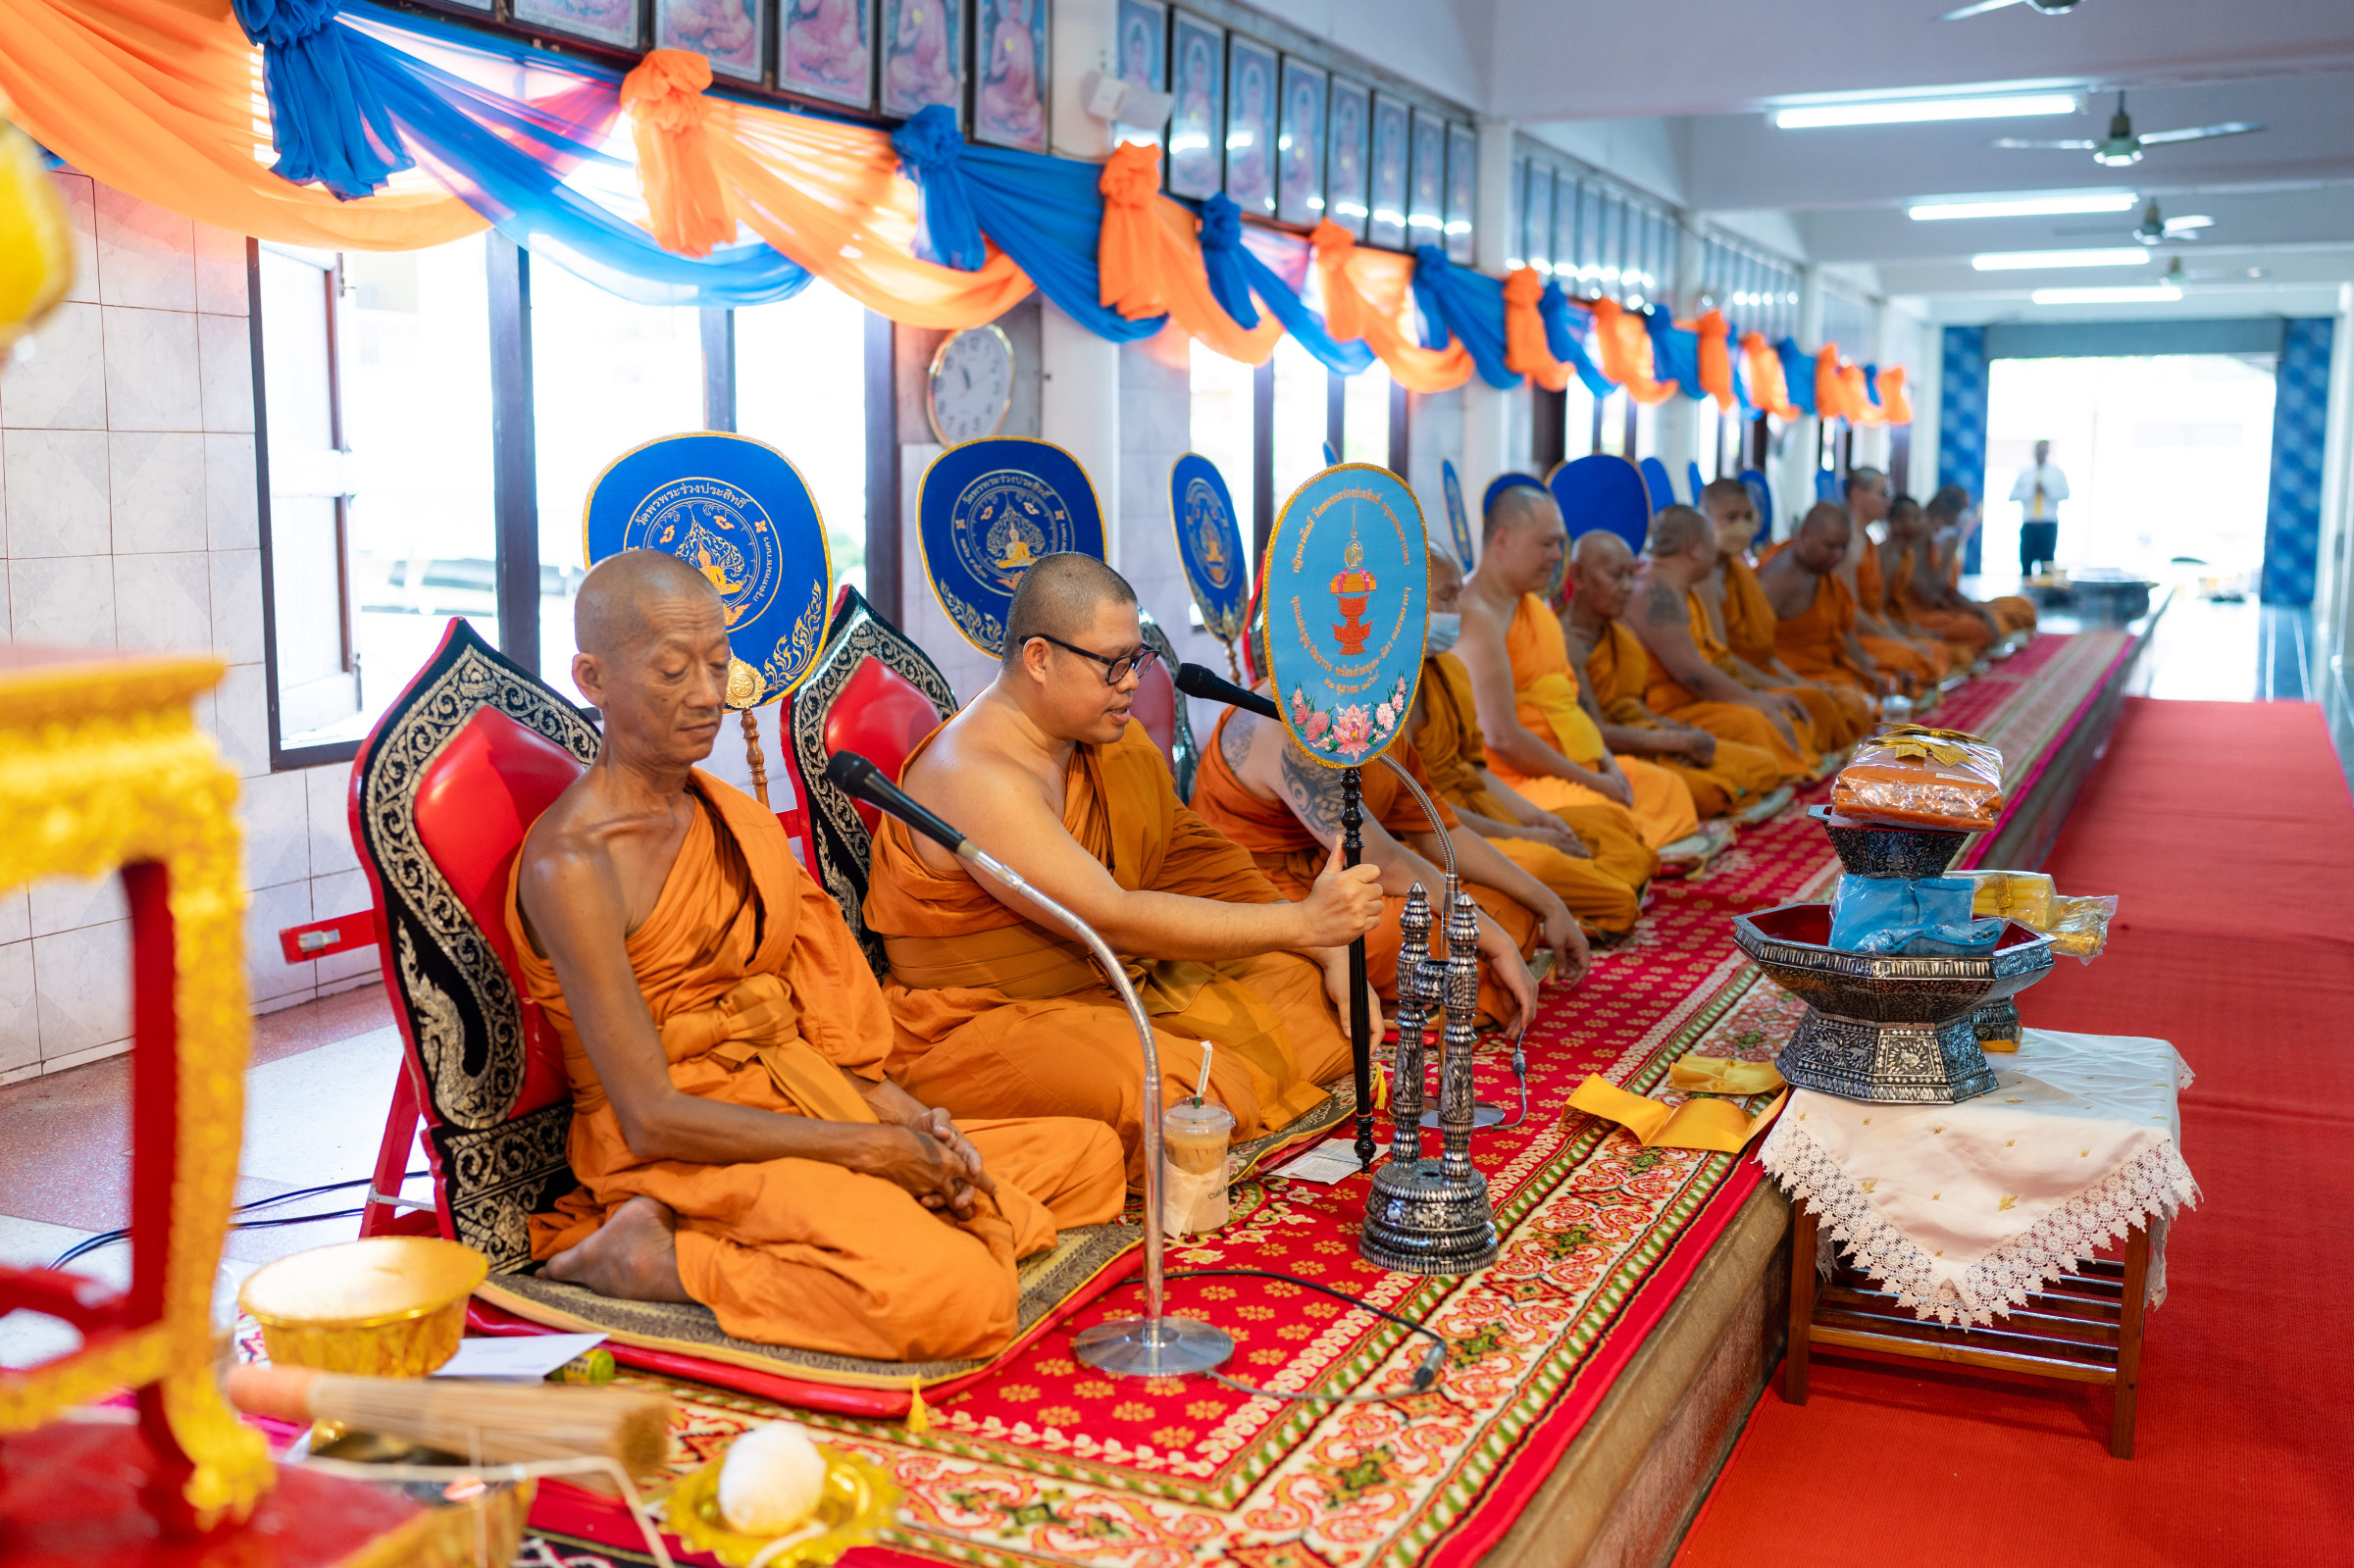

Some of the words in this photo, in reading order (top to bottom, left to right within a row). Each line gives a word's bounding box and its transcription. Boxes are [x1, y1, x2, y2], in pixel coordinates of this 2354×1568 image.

[635, 482, 750, 528] วัดพรพระร่วงประสิทธิ์
[753, 535, 774, 603] กรุงเทพมหานคร
